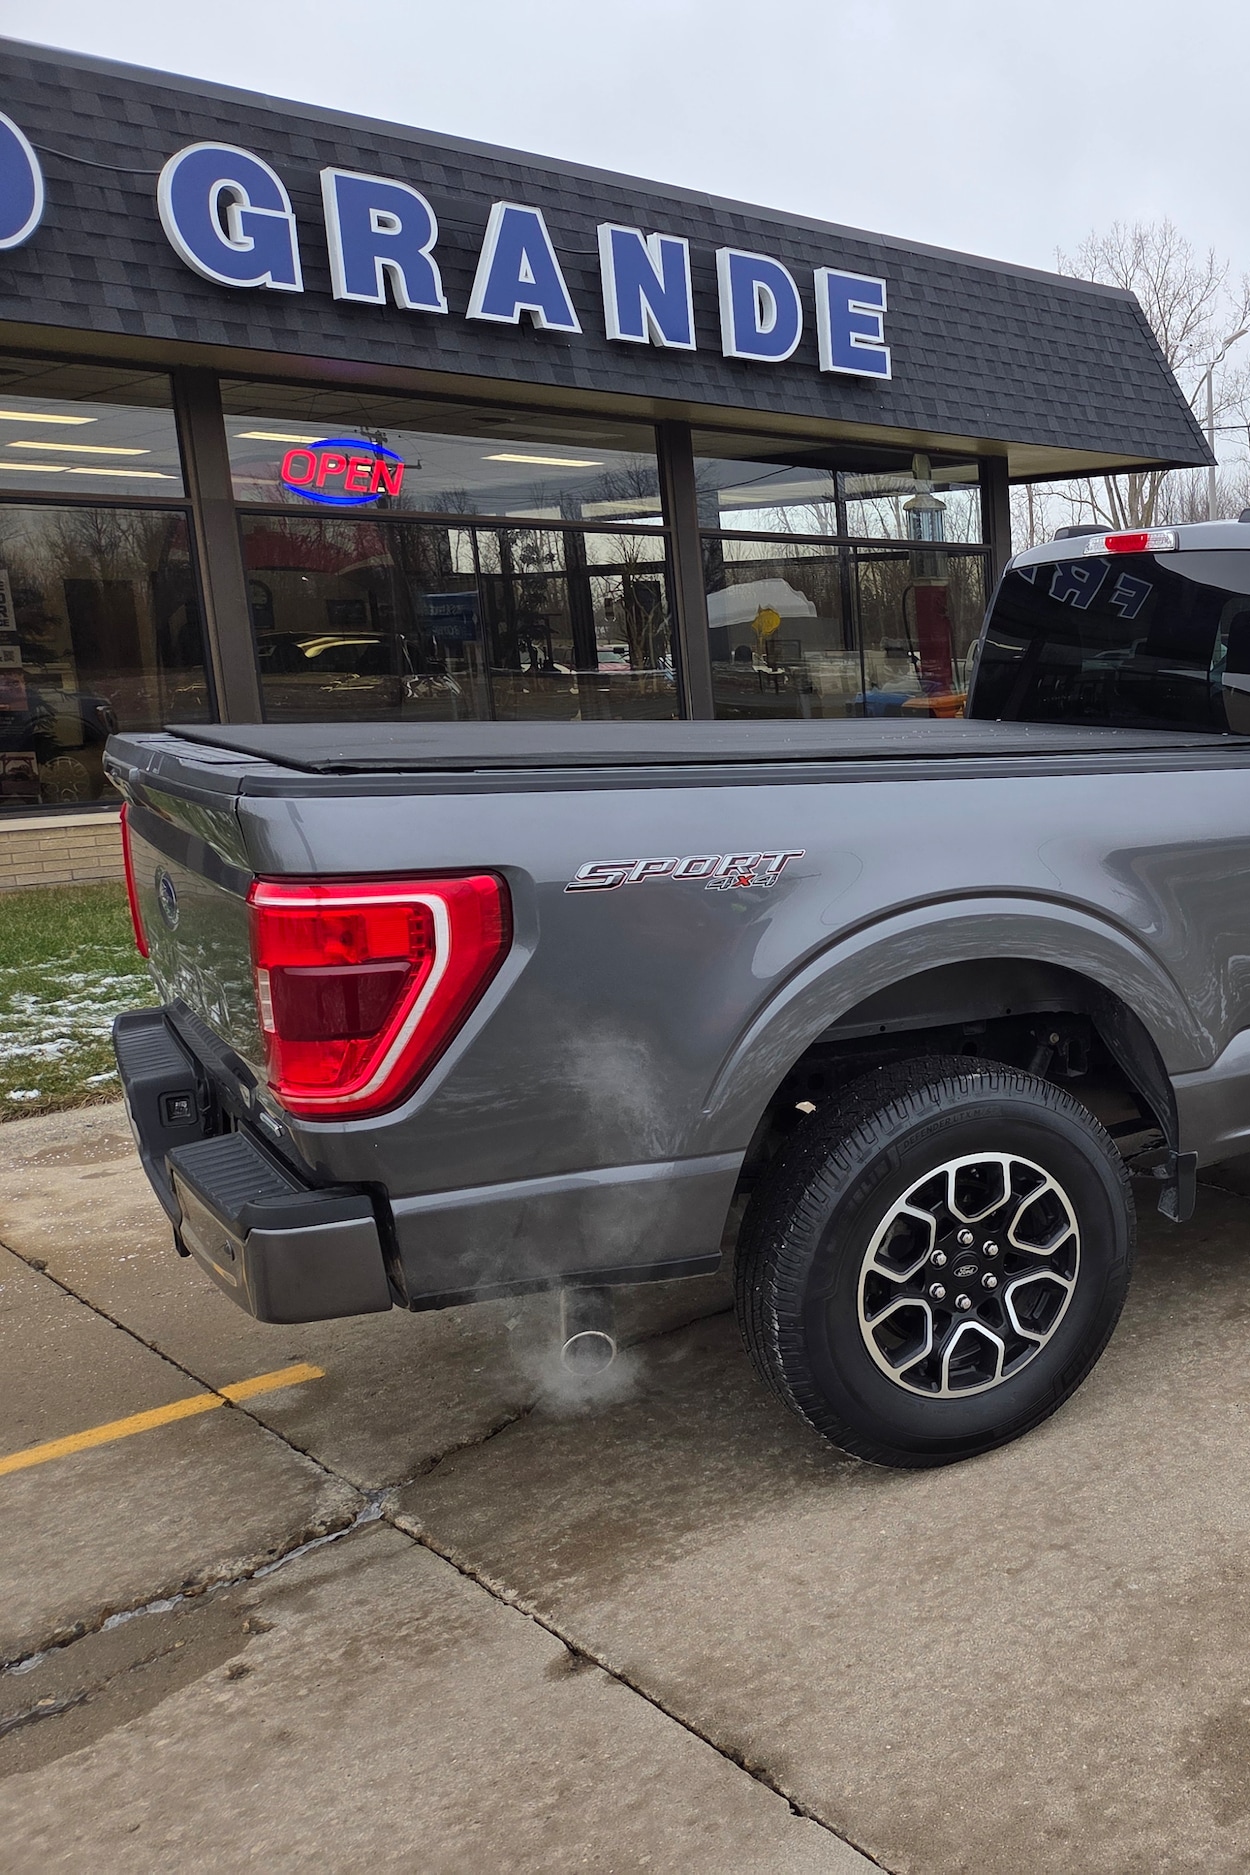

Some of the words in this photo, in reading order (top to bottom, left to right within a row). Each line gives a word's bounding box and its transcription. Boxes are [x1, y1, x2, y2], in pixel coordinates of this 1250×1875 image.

[157, 141, 892, 380] GRANDE
[281, 448, 405, 497] OPEN
[564, 849, 806, 893] SPORT
[903, 1117, 951, 1149] DEFENDER
